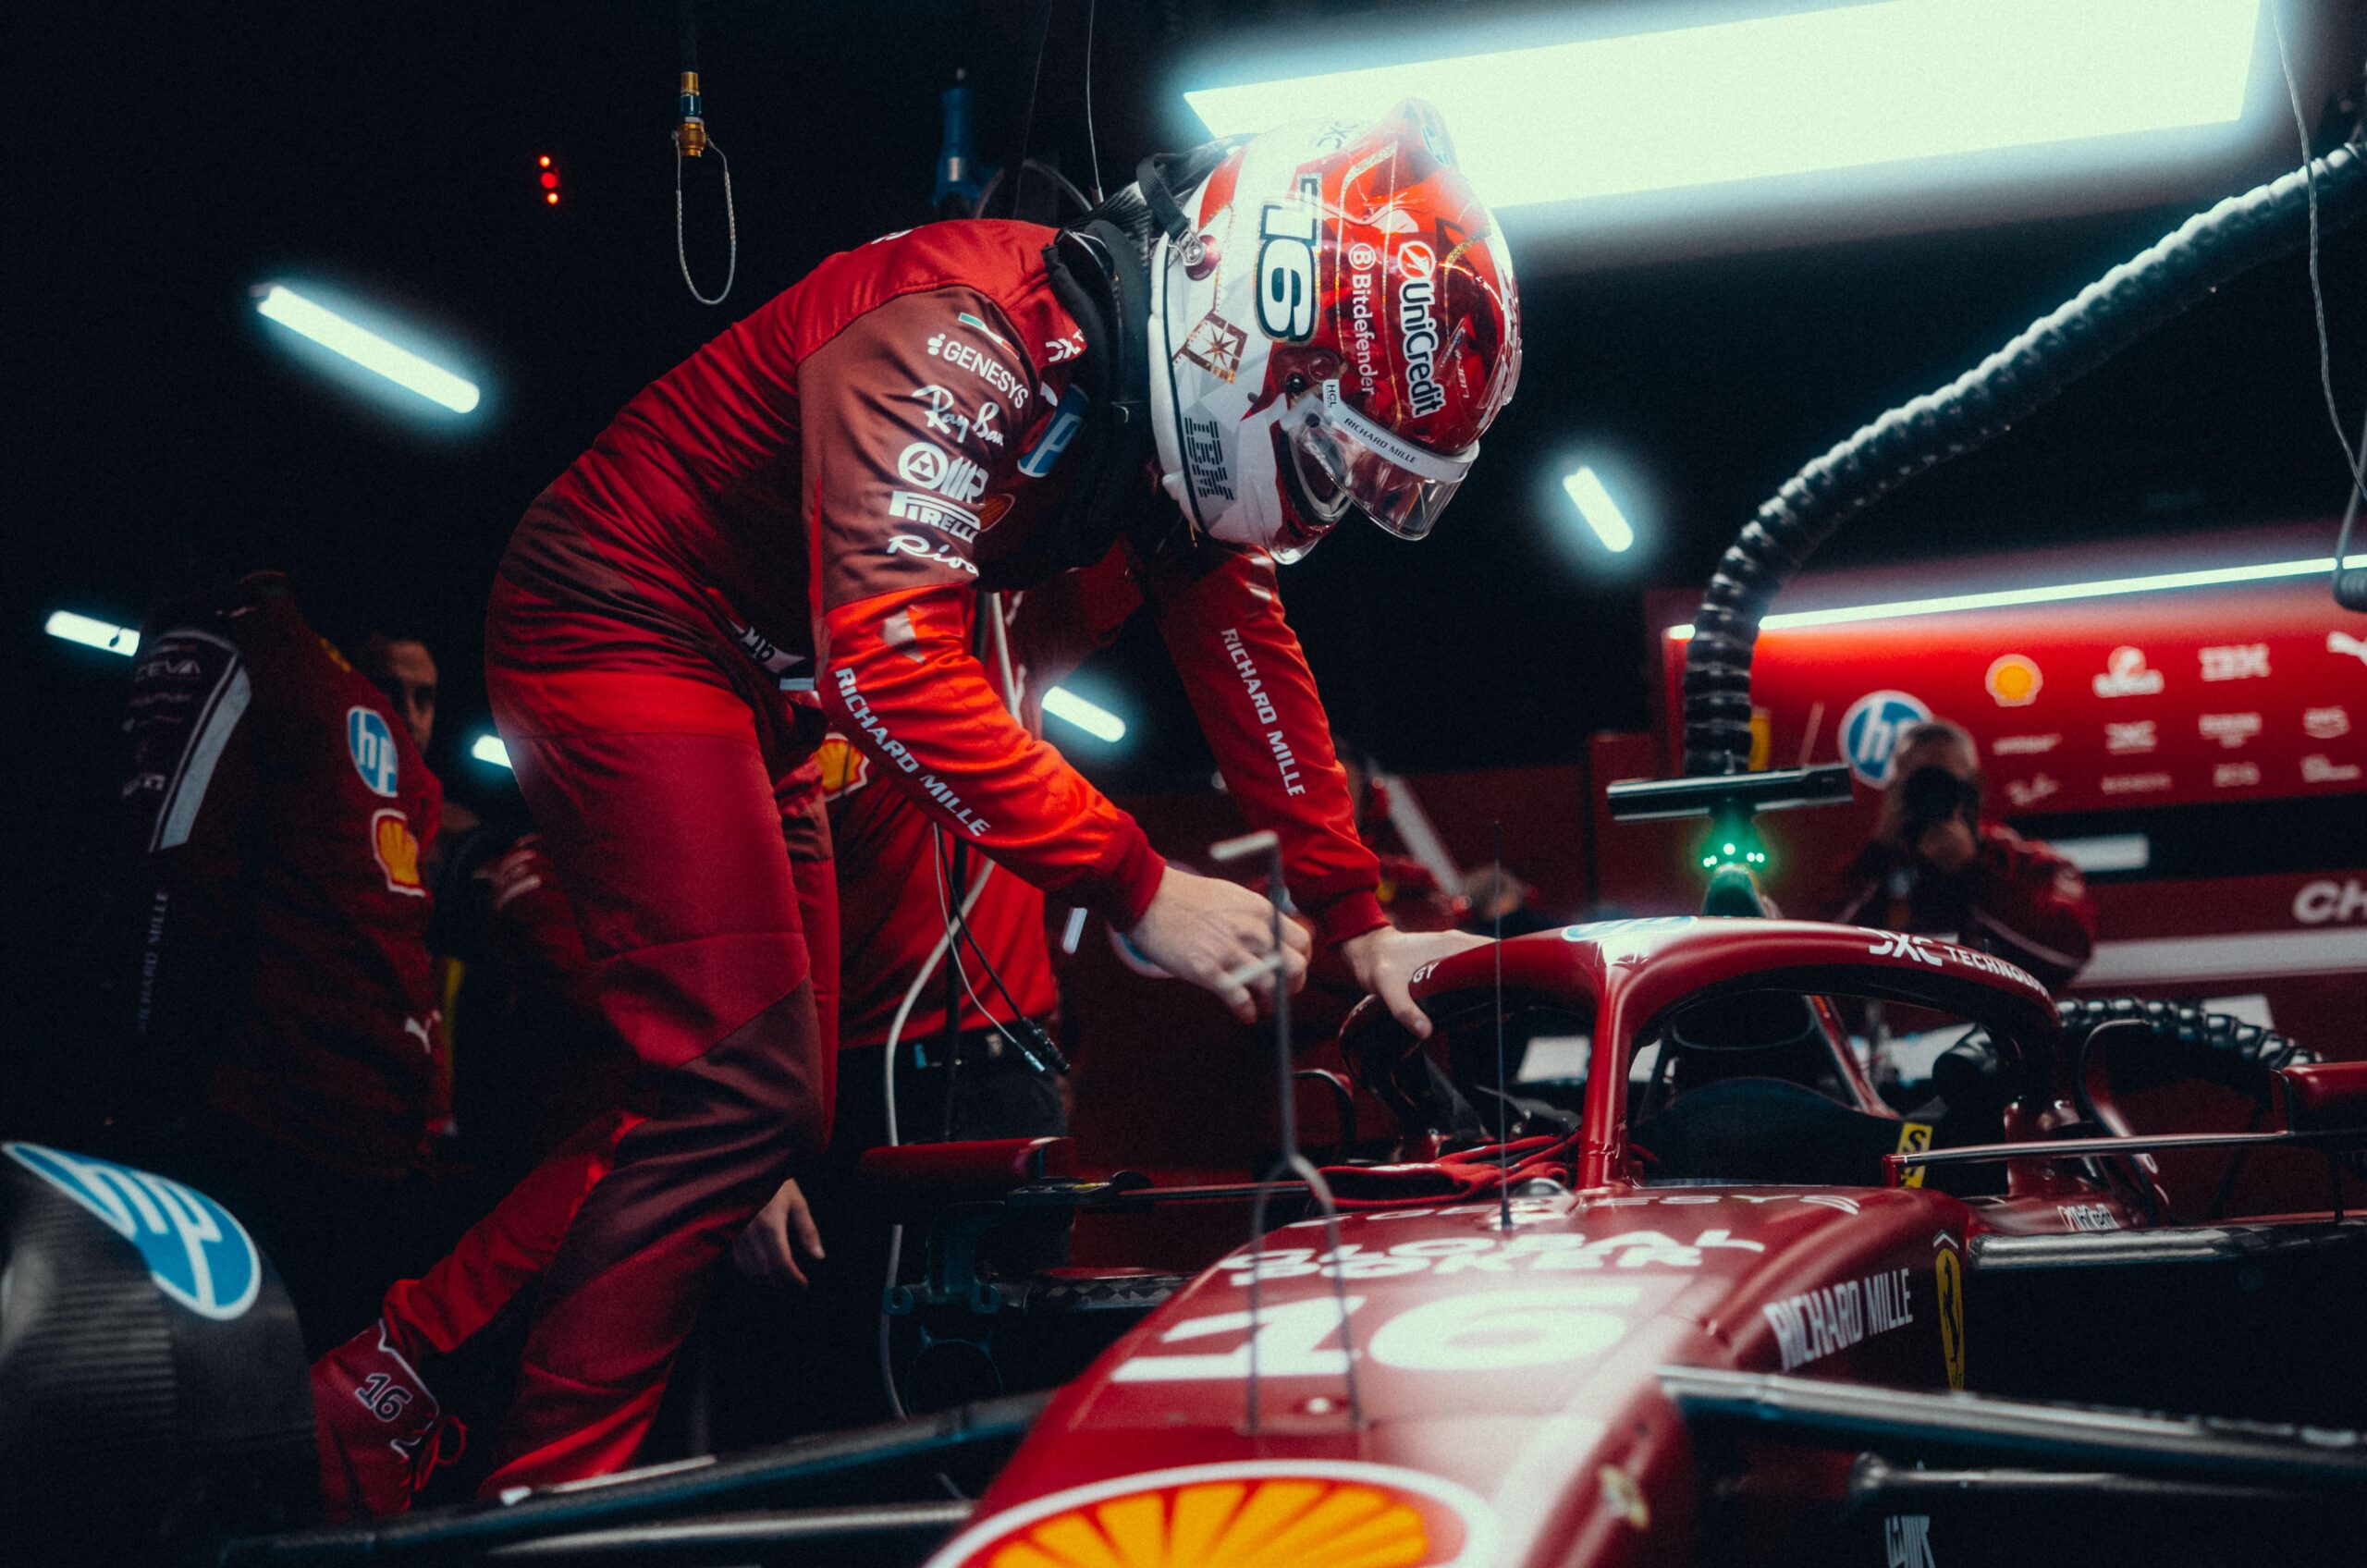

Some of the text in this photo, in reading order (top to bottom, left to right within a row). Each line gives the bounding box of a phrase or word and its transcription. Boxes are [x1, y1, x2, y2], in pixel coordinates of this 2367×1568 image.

[1254, 174, 1322, 345] 16
[943, 340, 1028, 409] GENESYS
[1351, 273, 1380, 398] Bitdefender
[1400, 280, 1446, 417] UniCredit
[1326, 384, 1337, 408] HCL
[1343, 417, 1417, 463] RICHARD MILLE
[1184, 417, 1234, 500] IBM
[886, 534, 980, 577] Riva
[835, 667, 992, 837] RICHARD MILLE
[1220, 628, 1306, 797] RICHARD MILLE
[1857, 926, 1943, 966] DXC
[1110, 1286, 1643, 1383] 16
[1763, 1268, 1914, 1373] RICHARD MILLE
[355, 1373, 413, 1423] 16
